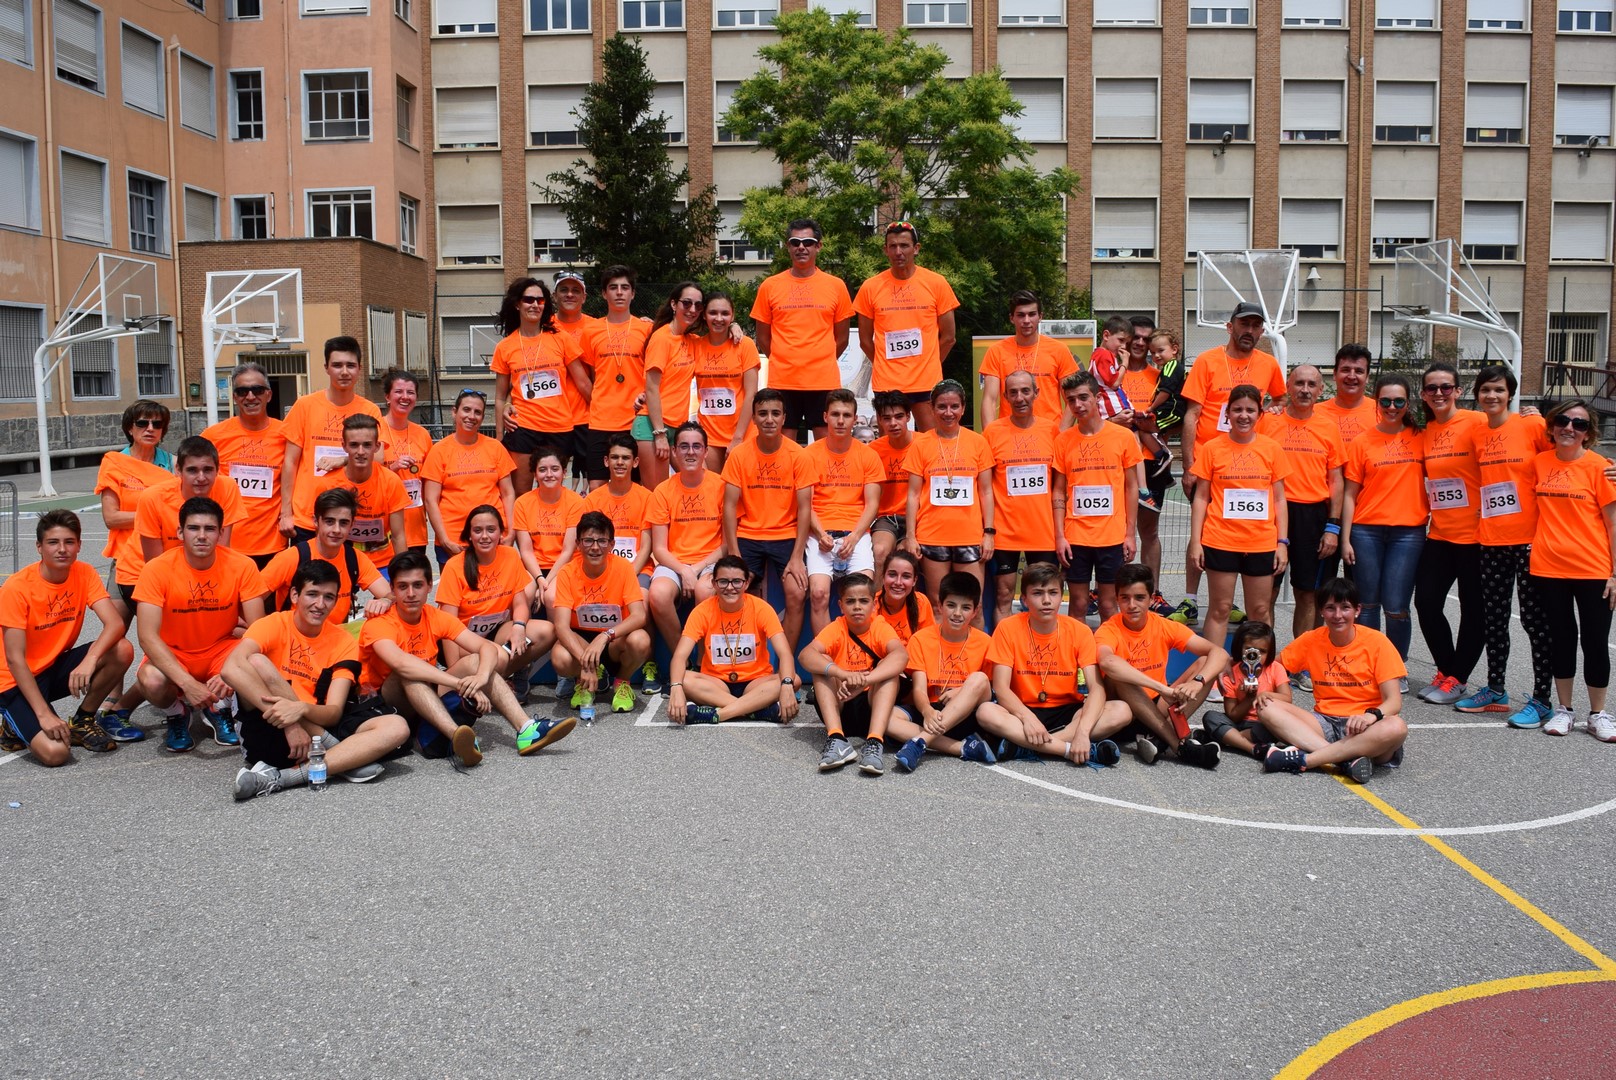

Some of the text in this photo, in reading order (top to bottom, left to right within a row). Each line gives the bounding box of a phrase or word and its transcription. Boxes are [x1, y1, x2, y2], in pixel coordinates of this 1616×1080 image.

[890, 339, 919, 352] 1539
[525, 379, 557, 392] 1566
[705, 399, 732, 408] 1188
[234, 478, 267, 490] 1071
[1012, 477, 1044, 488] 1185
[408, 490, 418, 500] 57
[1432, 489, 1463, 502] 1553
[1076, 498, 1109, 508] 1052
[1229, 501, 1264, 512] 1563
[1485, 494, 1516, 510] 1538
[350, 527, 380, 536] 249
[612, 549, 633, 559] 065
[46, 606, 76, 618] Provencio
[583, 614, 618, 624] 1064
